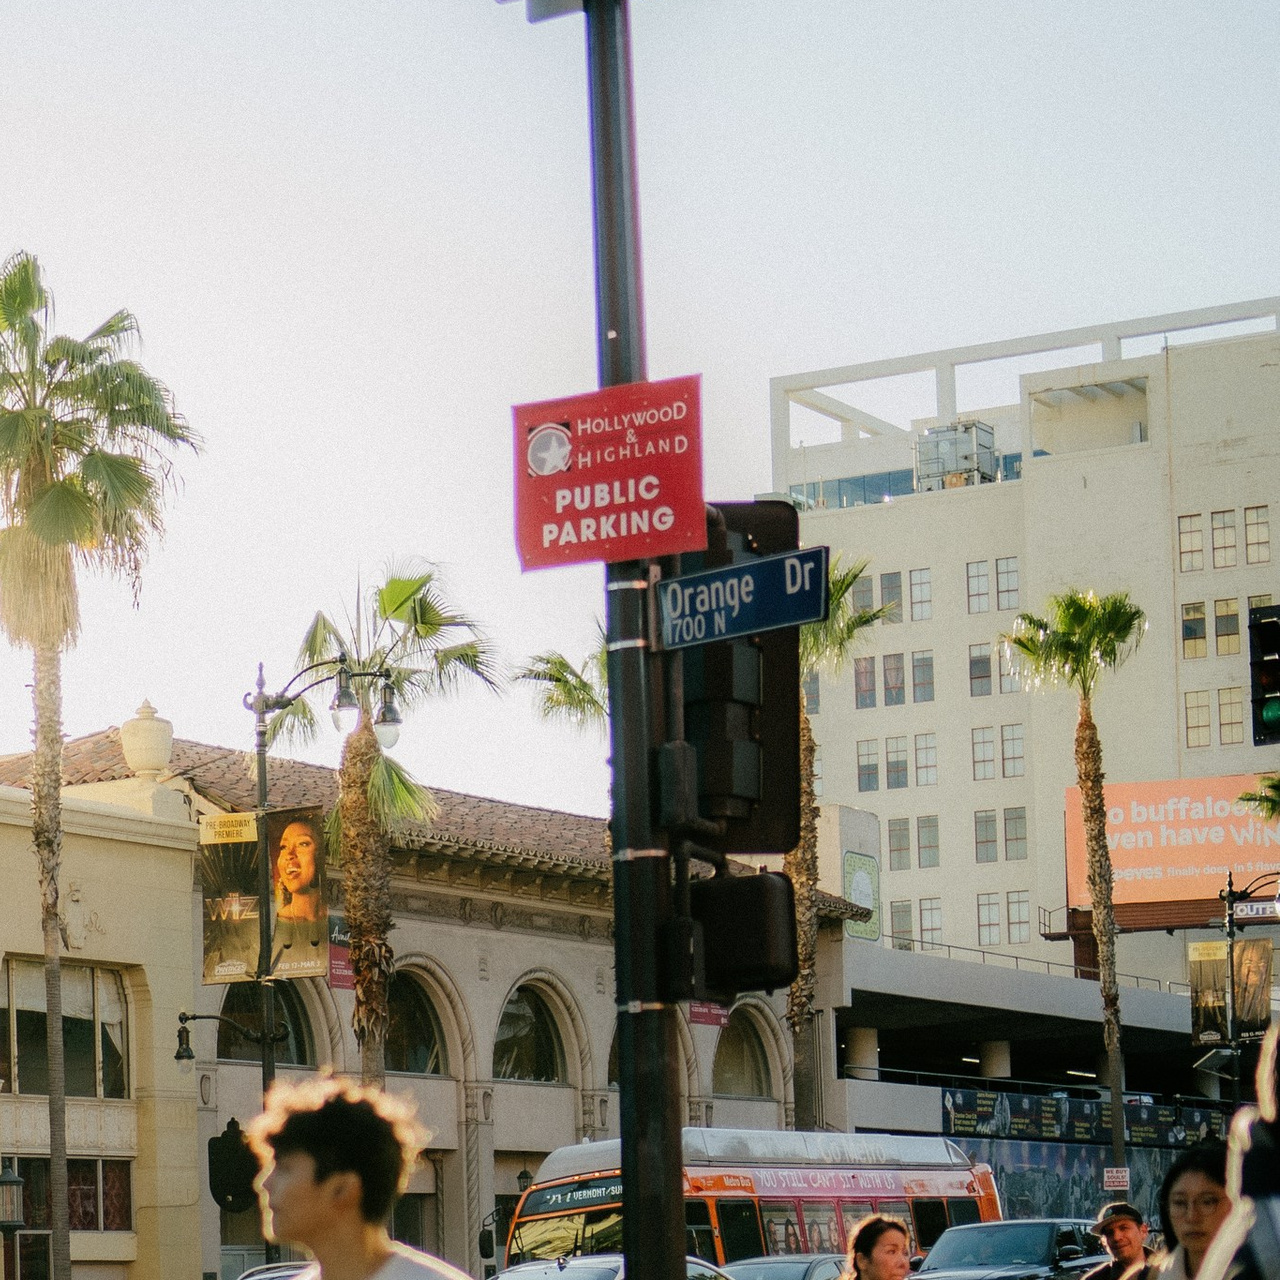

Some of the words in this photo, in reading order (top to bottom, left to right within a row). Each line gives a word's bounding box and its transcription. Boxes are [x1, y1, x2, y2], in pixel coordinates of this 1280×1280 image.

[577, 401, 688, 436] HOLLYWOOD
[625, 429, 639, 444] &
[577, 435, 689, 470] HIGHLAND
[555, 474, 661, 513] PUBLIC
[542, 506, 675, 548] PARKING
[666, 574, 755, 619] Orange
[784, 557, 815, 595] Dr
[713, 610, 726, 635] N
[1108, 806, 1124, 825] o
[213, 829, 243, 839] PREMIERE
[1106, 829, 1153, 850] ven
[1159, 824, 1225, 847] have
[204, 896, 260, 921] WIZ
[756, 1170, 778, 1188] YOU
[779, 1171, 808, 1188] STILL
[808, 1172, 837, 1188] CAN'T
[839, 1172, 856, 1189] SIT
[859, 1172, 883, 1189] WITH
[883, 1173, 896, 1190] US
